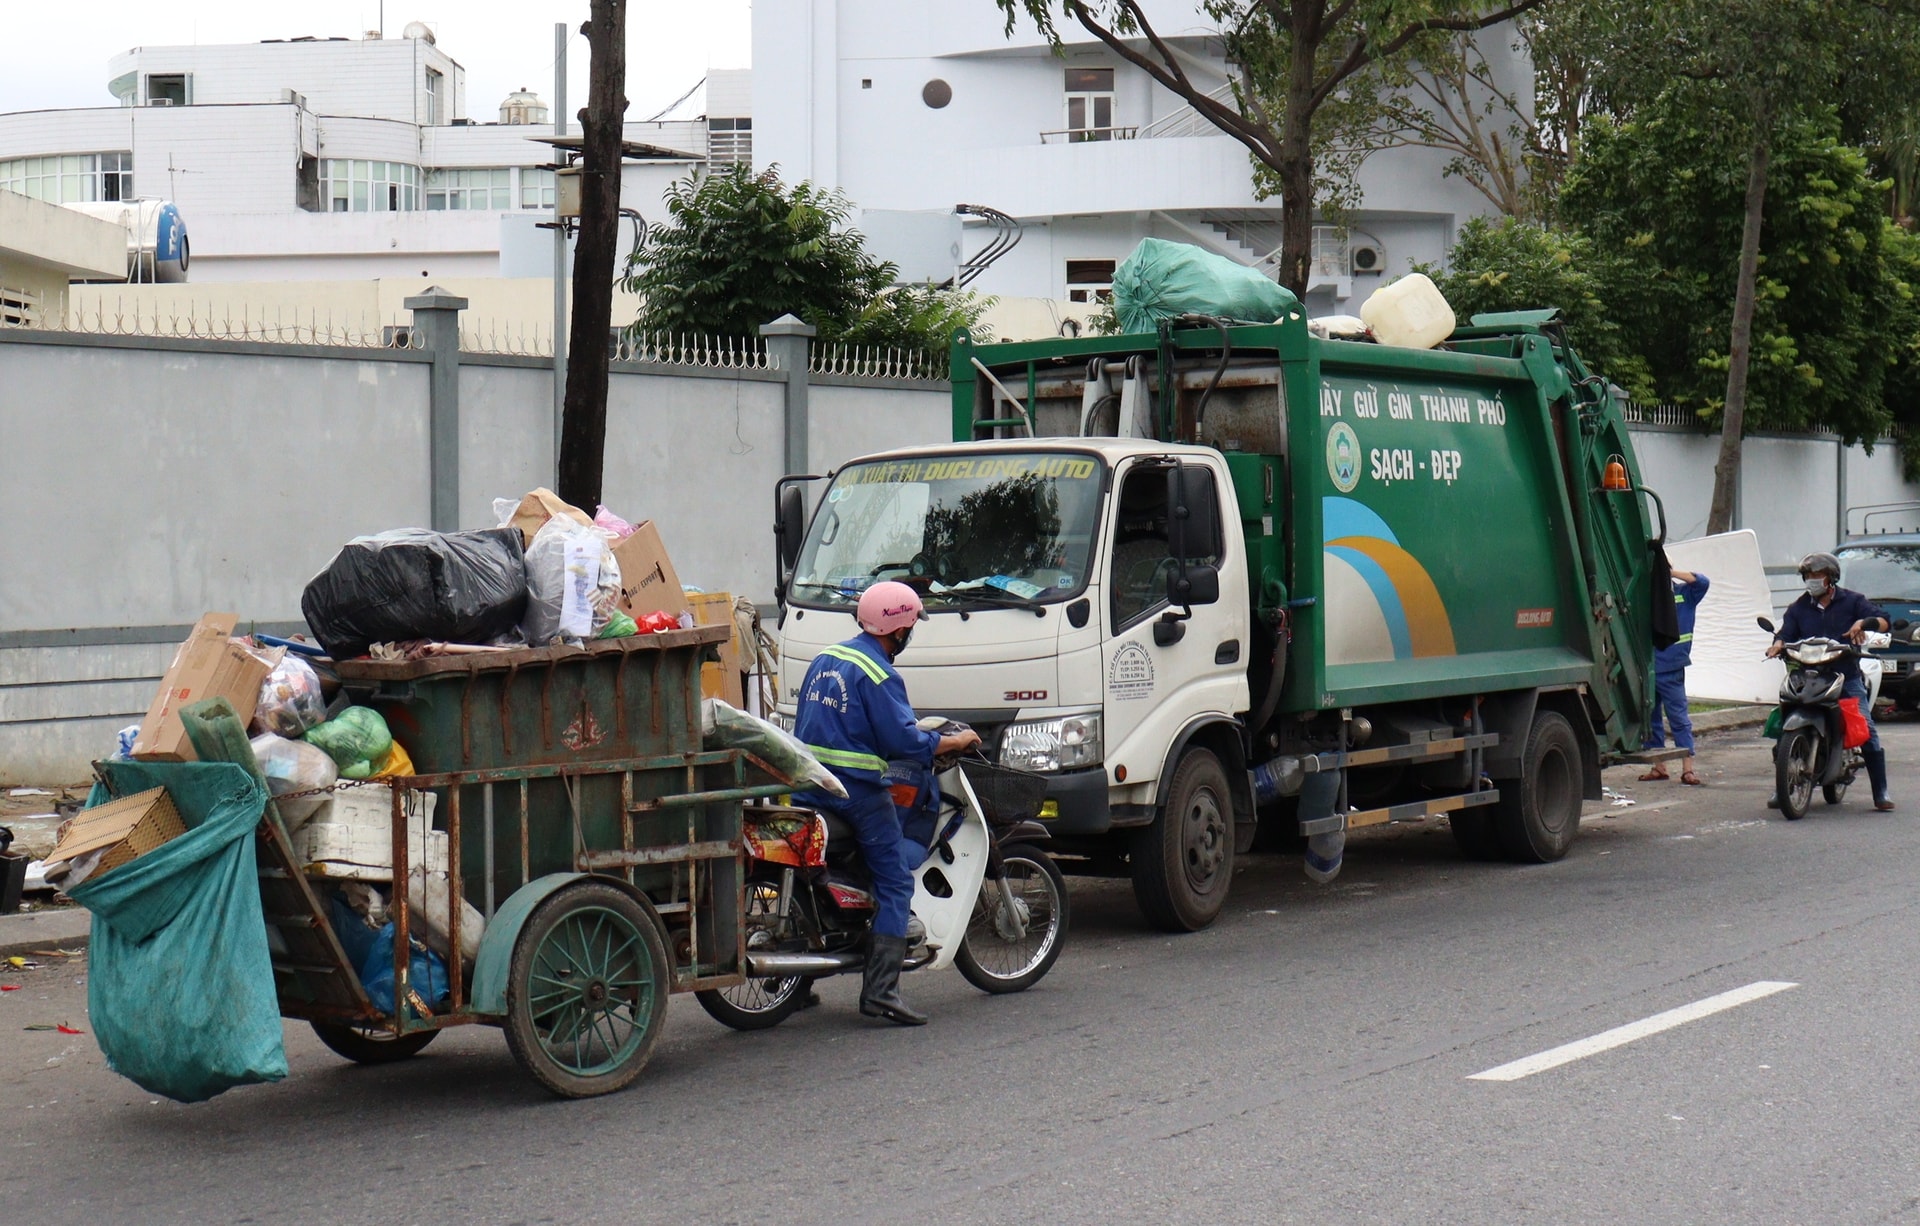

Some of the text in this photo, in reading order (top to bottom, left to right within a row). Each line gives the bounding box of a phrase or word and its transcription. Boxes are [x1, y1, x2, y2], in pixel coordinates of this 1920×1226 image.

[1354, 383, 1378, 418] GIỮ
[1388, 384, 1413, 420] GÌN
[1419, 387, 1470, 423] THÀNH
[1477, 388, 1506, 425] PHỐ
[1023, 457, 1095, 481] AUTO
[1370, 448, 1414, 486] SẠCH
[1431, 449, 1461, 486] ĐẸP
[640, 570, 657, 588] EXPORT
[1003, 690, 1048, 701] 300
